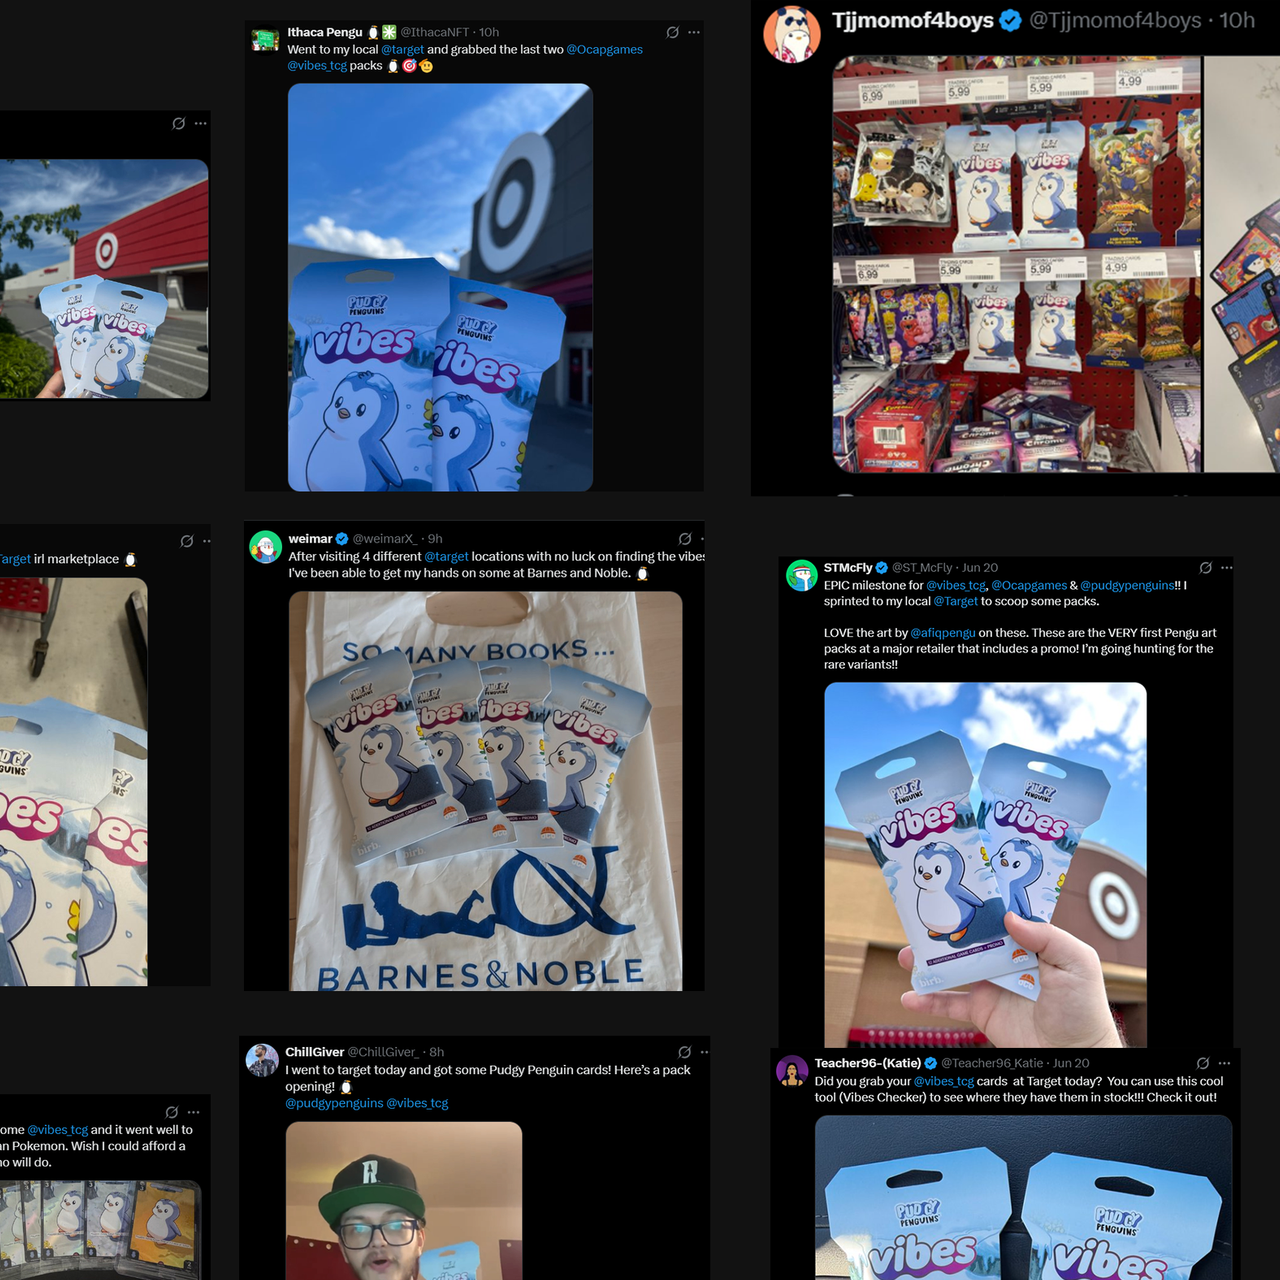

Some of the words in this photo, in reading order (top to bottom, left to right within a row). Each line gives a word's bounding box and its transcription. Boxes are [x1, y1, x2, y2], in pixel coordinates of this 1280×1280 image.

[831, 10, 995, 33] Tjjmomof4boys
[1030, 10, 1202, 33] @Tjjmomof4boys
[287, 59, 348, 73] @vibes_tcg
[349, 59, 383, 73] packs
[1118, 76, 1142, 87] 4.99
[861, 91, 883, 102] 6.99
[948, 87, 971, 98] 5.99
[960, 156, 1002, 172] vibes
[349, 308, 385, 316] PENGUINS
[314, 322, 415, 364] vibes
[824, 661, 846, 670] rare
[847, 658, 898, 670] variants!!
[335, 693, 398, 732] vibes
[900, 1214, 940, 1227] PENGUINS
[869, 1233, 977, 1280] vibes
